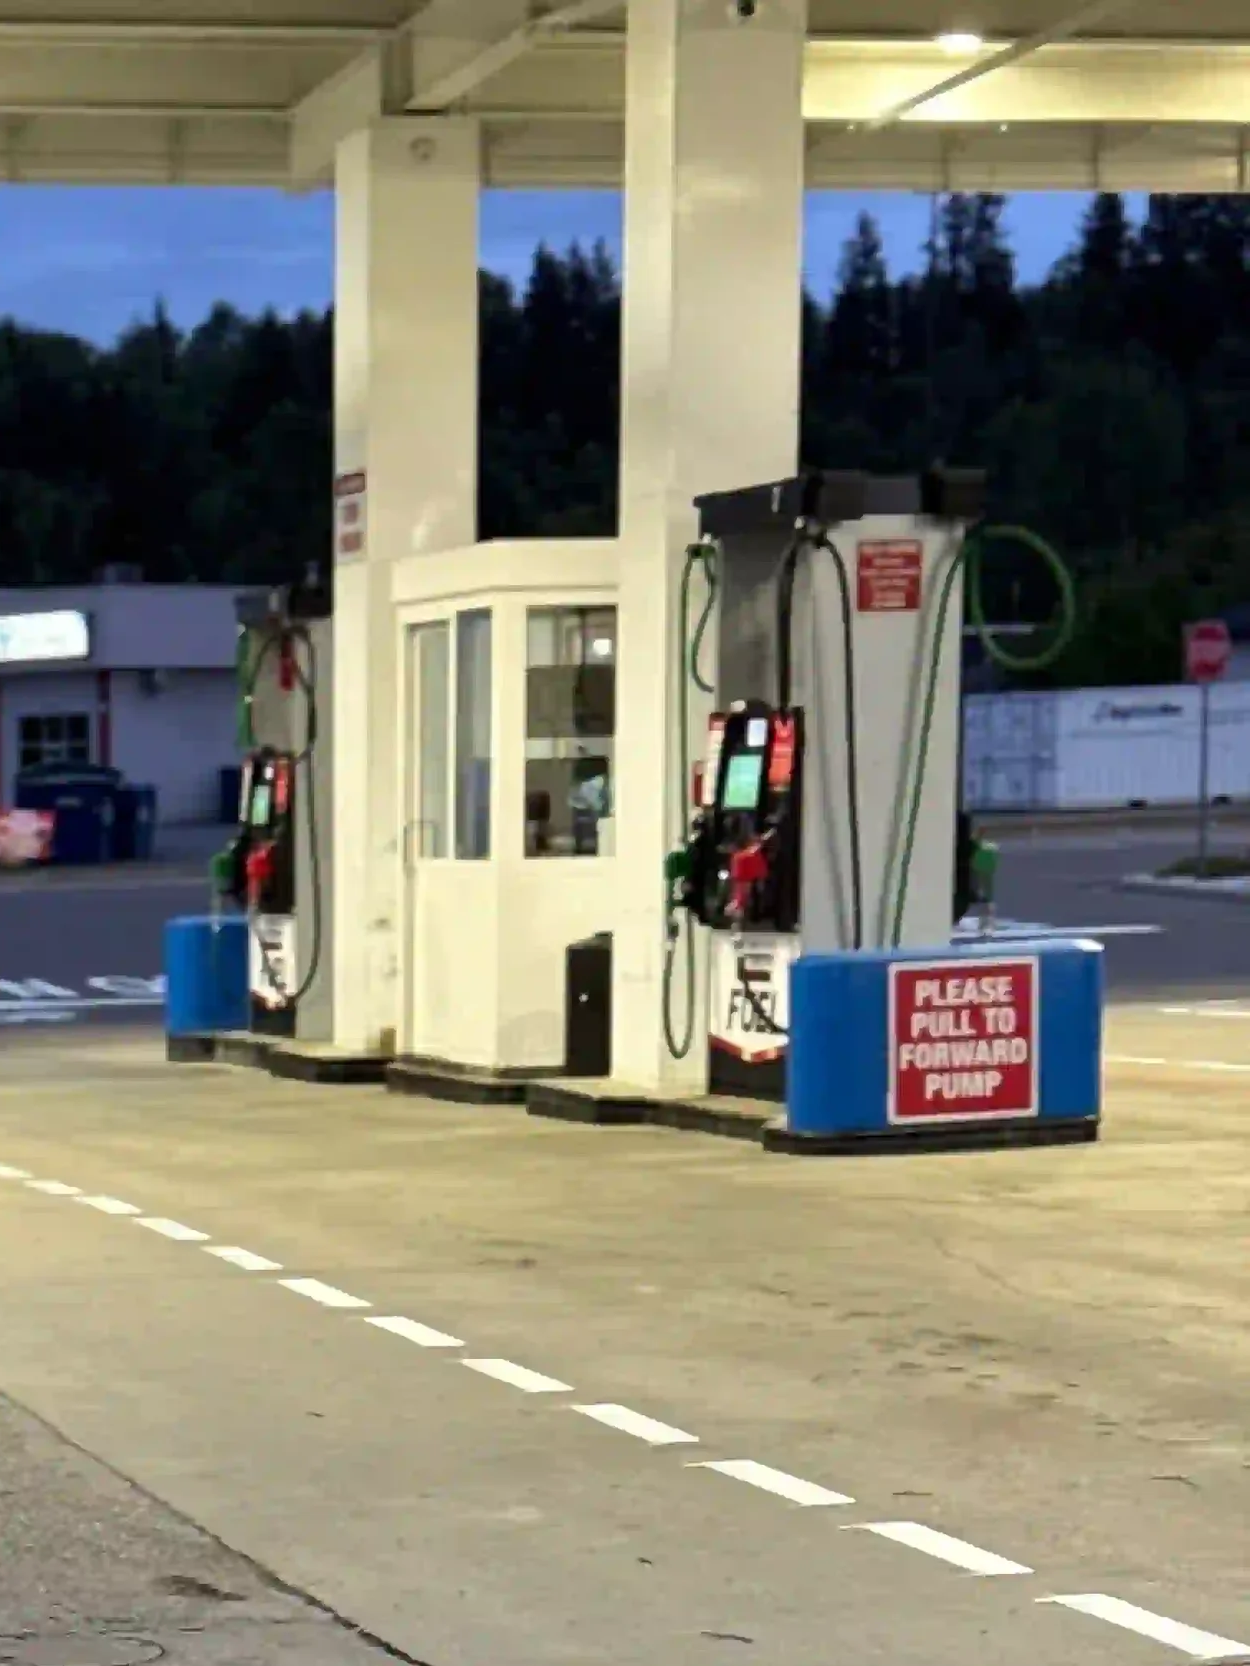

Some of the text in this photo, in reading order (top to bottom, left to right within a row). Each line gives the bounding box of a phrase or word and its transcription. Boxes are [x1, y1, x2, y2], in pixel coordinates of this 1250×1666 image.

[915, 976, 1014, 1006] PLEASE
[910, 1007, 1016, 1038] PULL TO
[899, 1037, 1028, 1071] FORWARD
[925, 1071, 1003, 1100] PUMP
